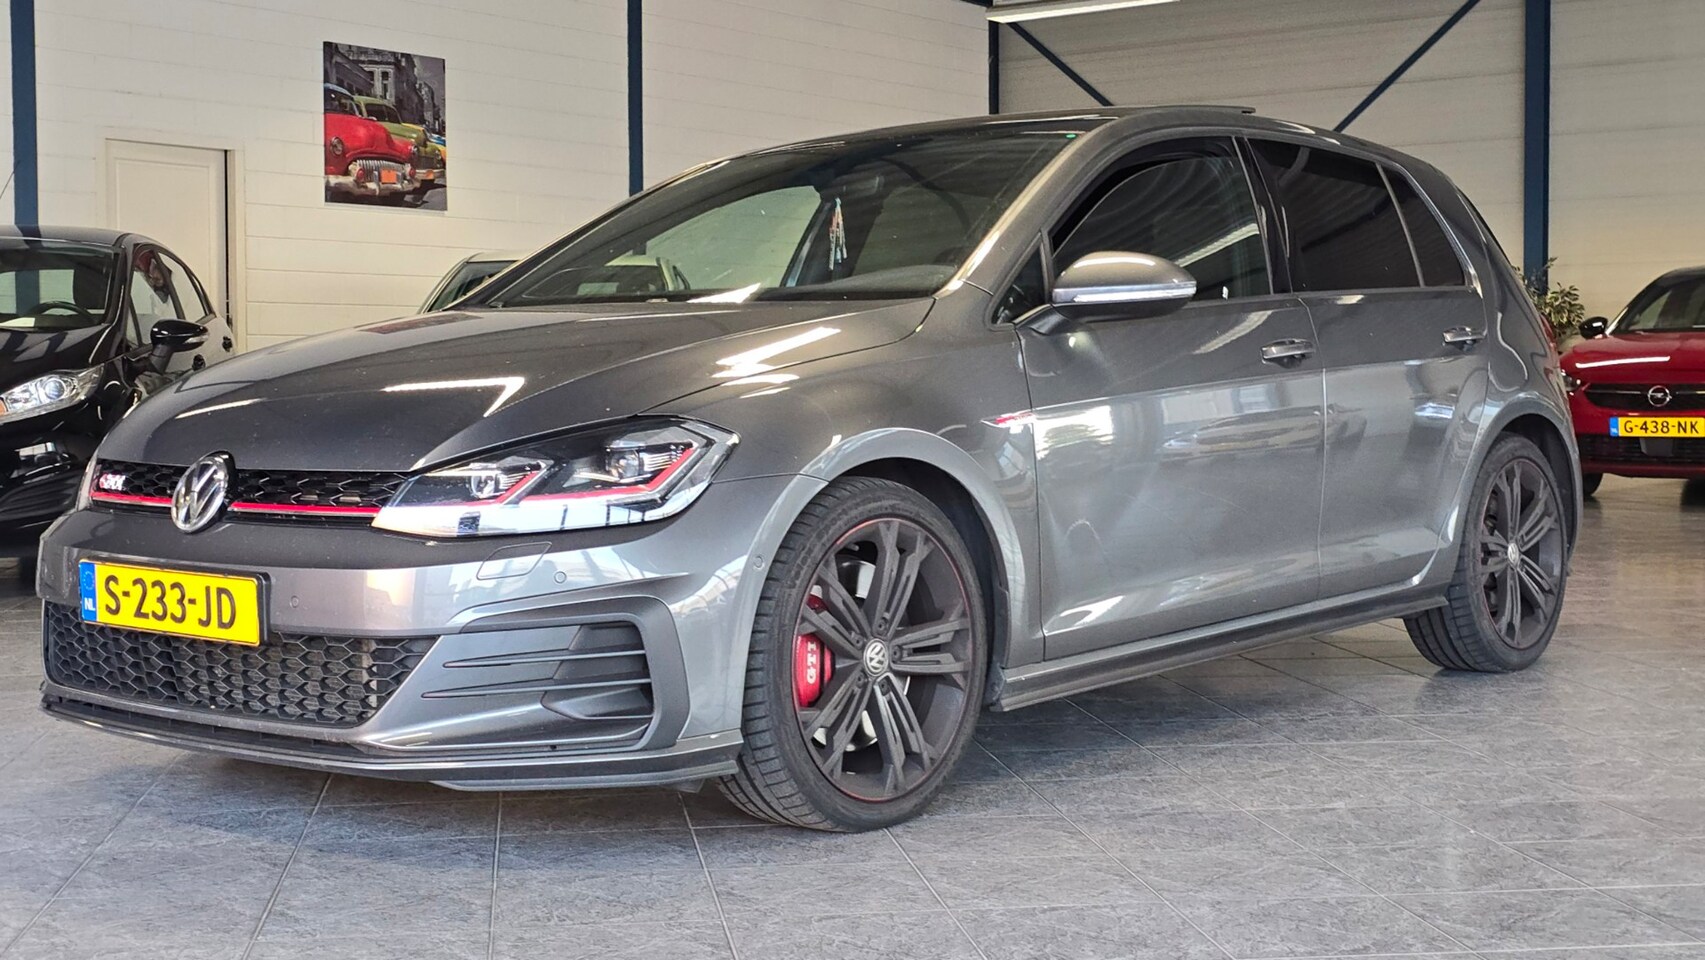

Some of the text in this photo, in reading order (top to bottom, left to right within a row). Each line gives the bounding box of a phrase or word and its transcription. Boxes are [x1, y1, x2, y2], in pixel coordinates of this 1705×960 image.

[1624, 420, 1699, 434] G-438-NK
[84, 597, 96, 611] NL
[104, 574, 236, 630] S-233-JD
[807, 641, 817, 684] GTI
